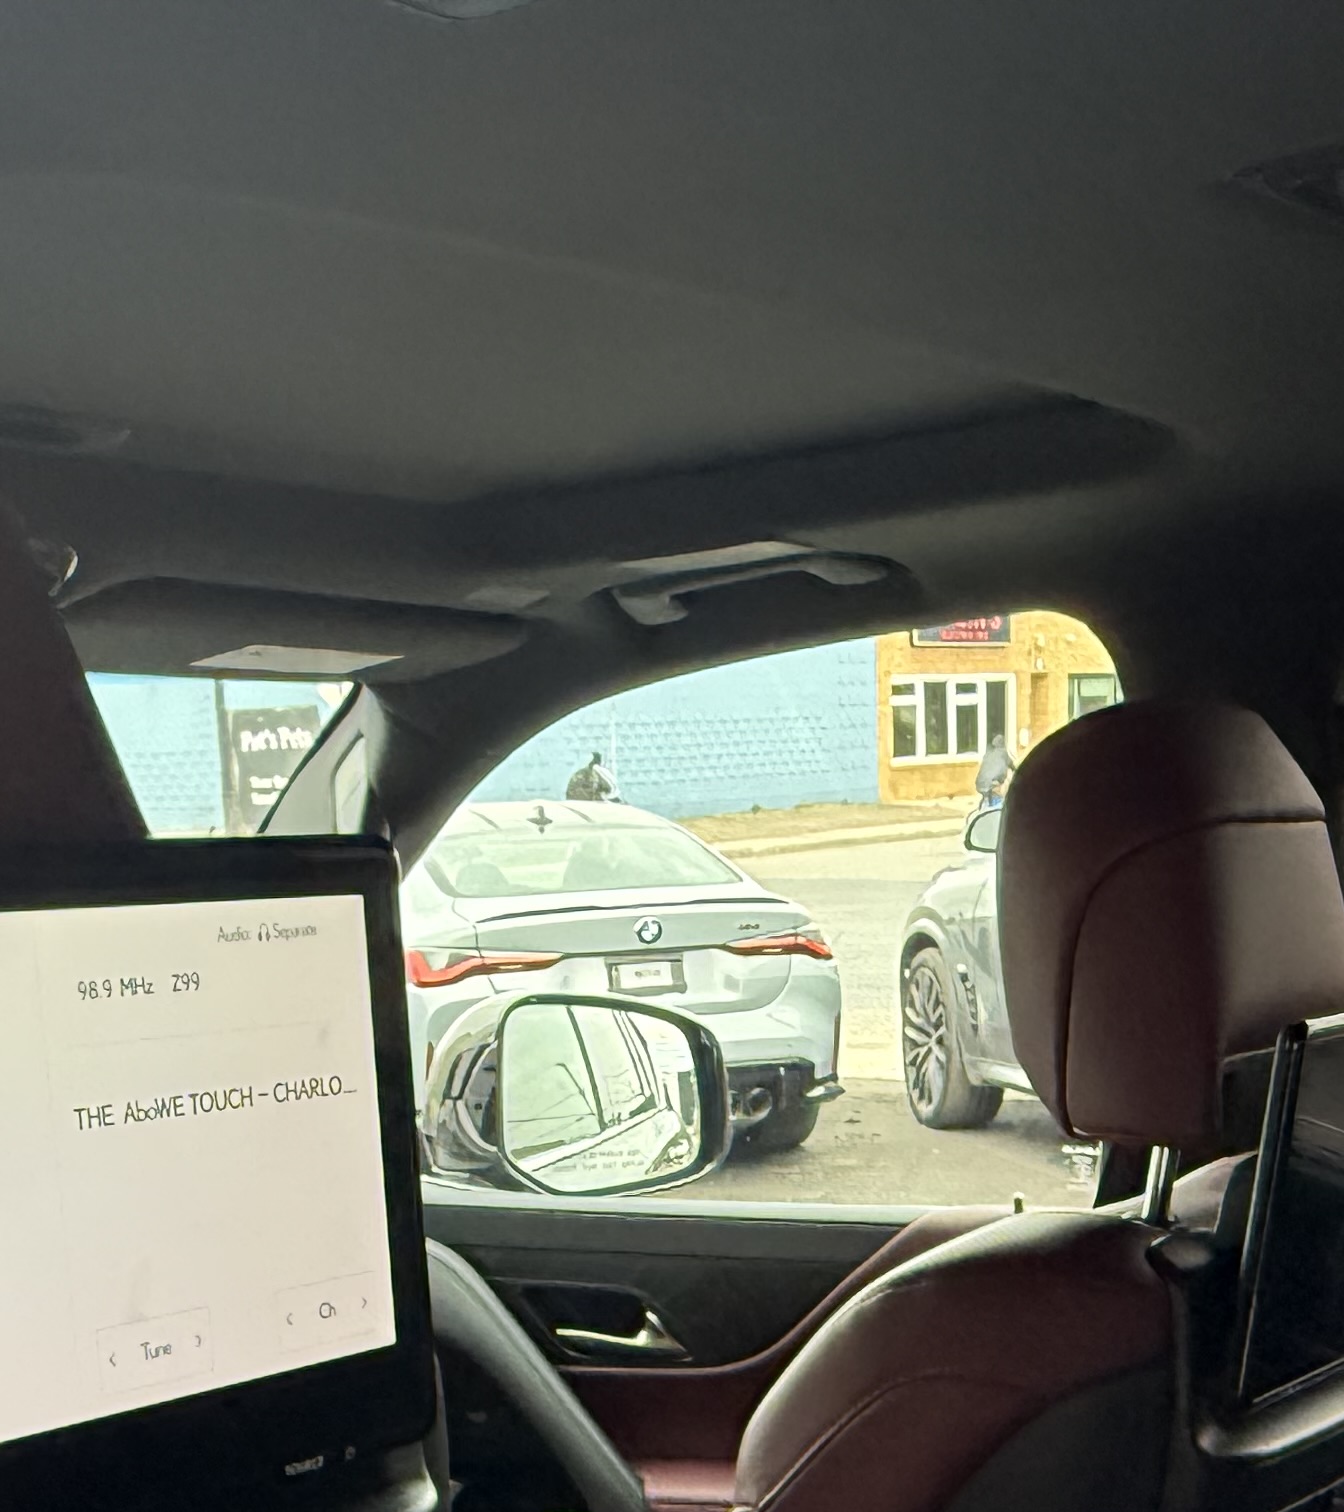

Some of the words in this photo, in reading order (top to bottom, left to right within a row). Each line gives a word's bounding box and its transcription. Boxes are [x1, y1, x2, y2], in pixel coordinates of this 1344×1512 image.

[77, 978, 113, 1000] 98.9
[120, 976, 155, 997] MHz
[171, 972, 201, 993] Z99
[73, 1104, 116, 1131] THE
[187, 1085, 255, 1115] TOUCH
[140, 1341, 173, 1361] Tune
